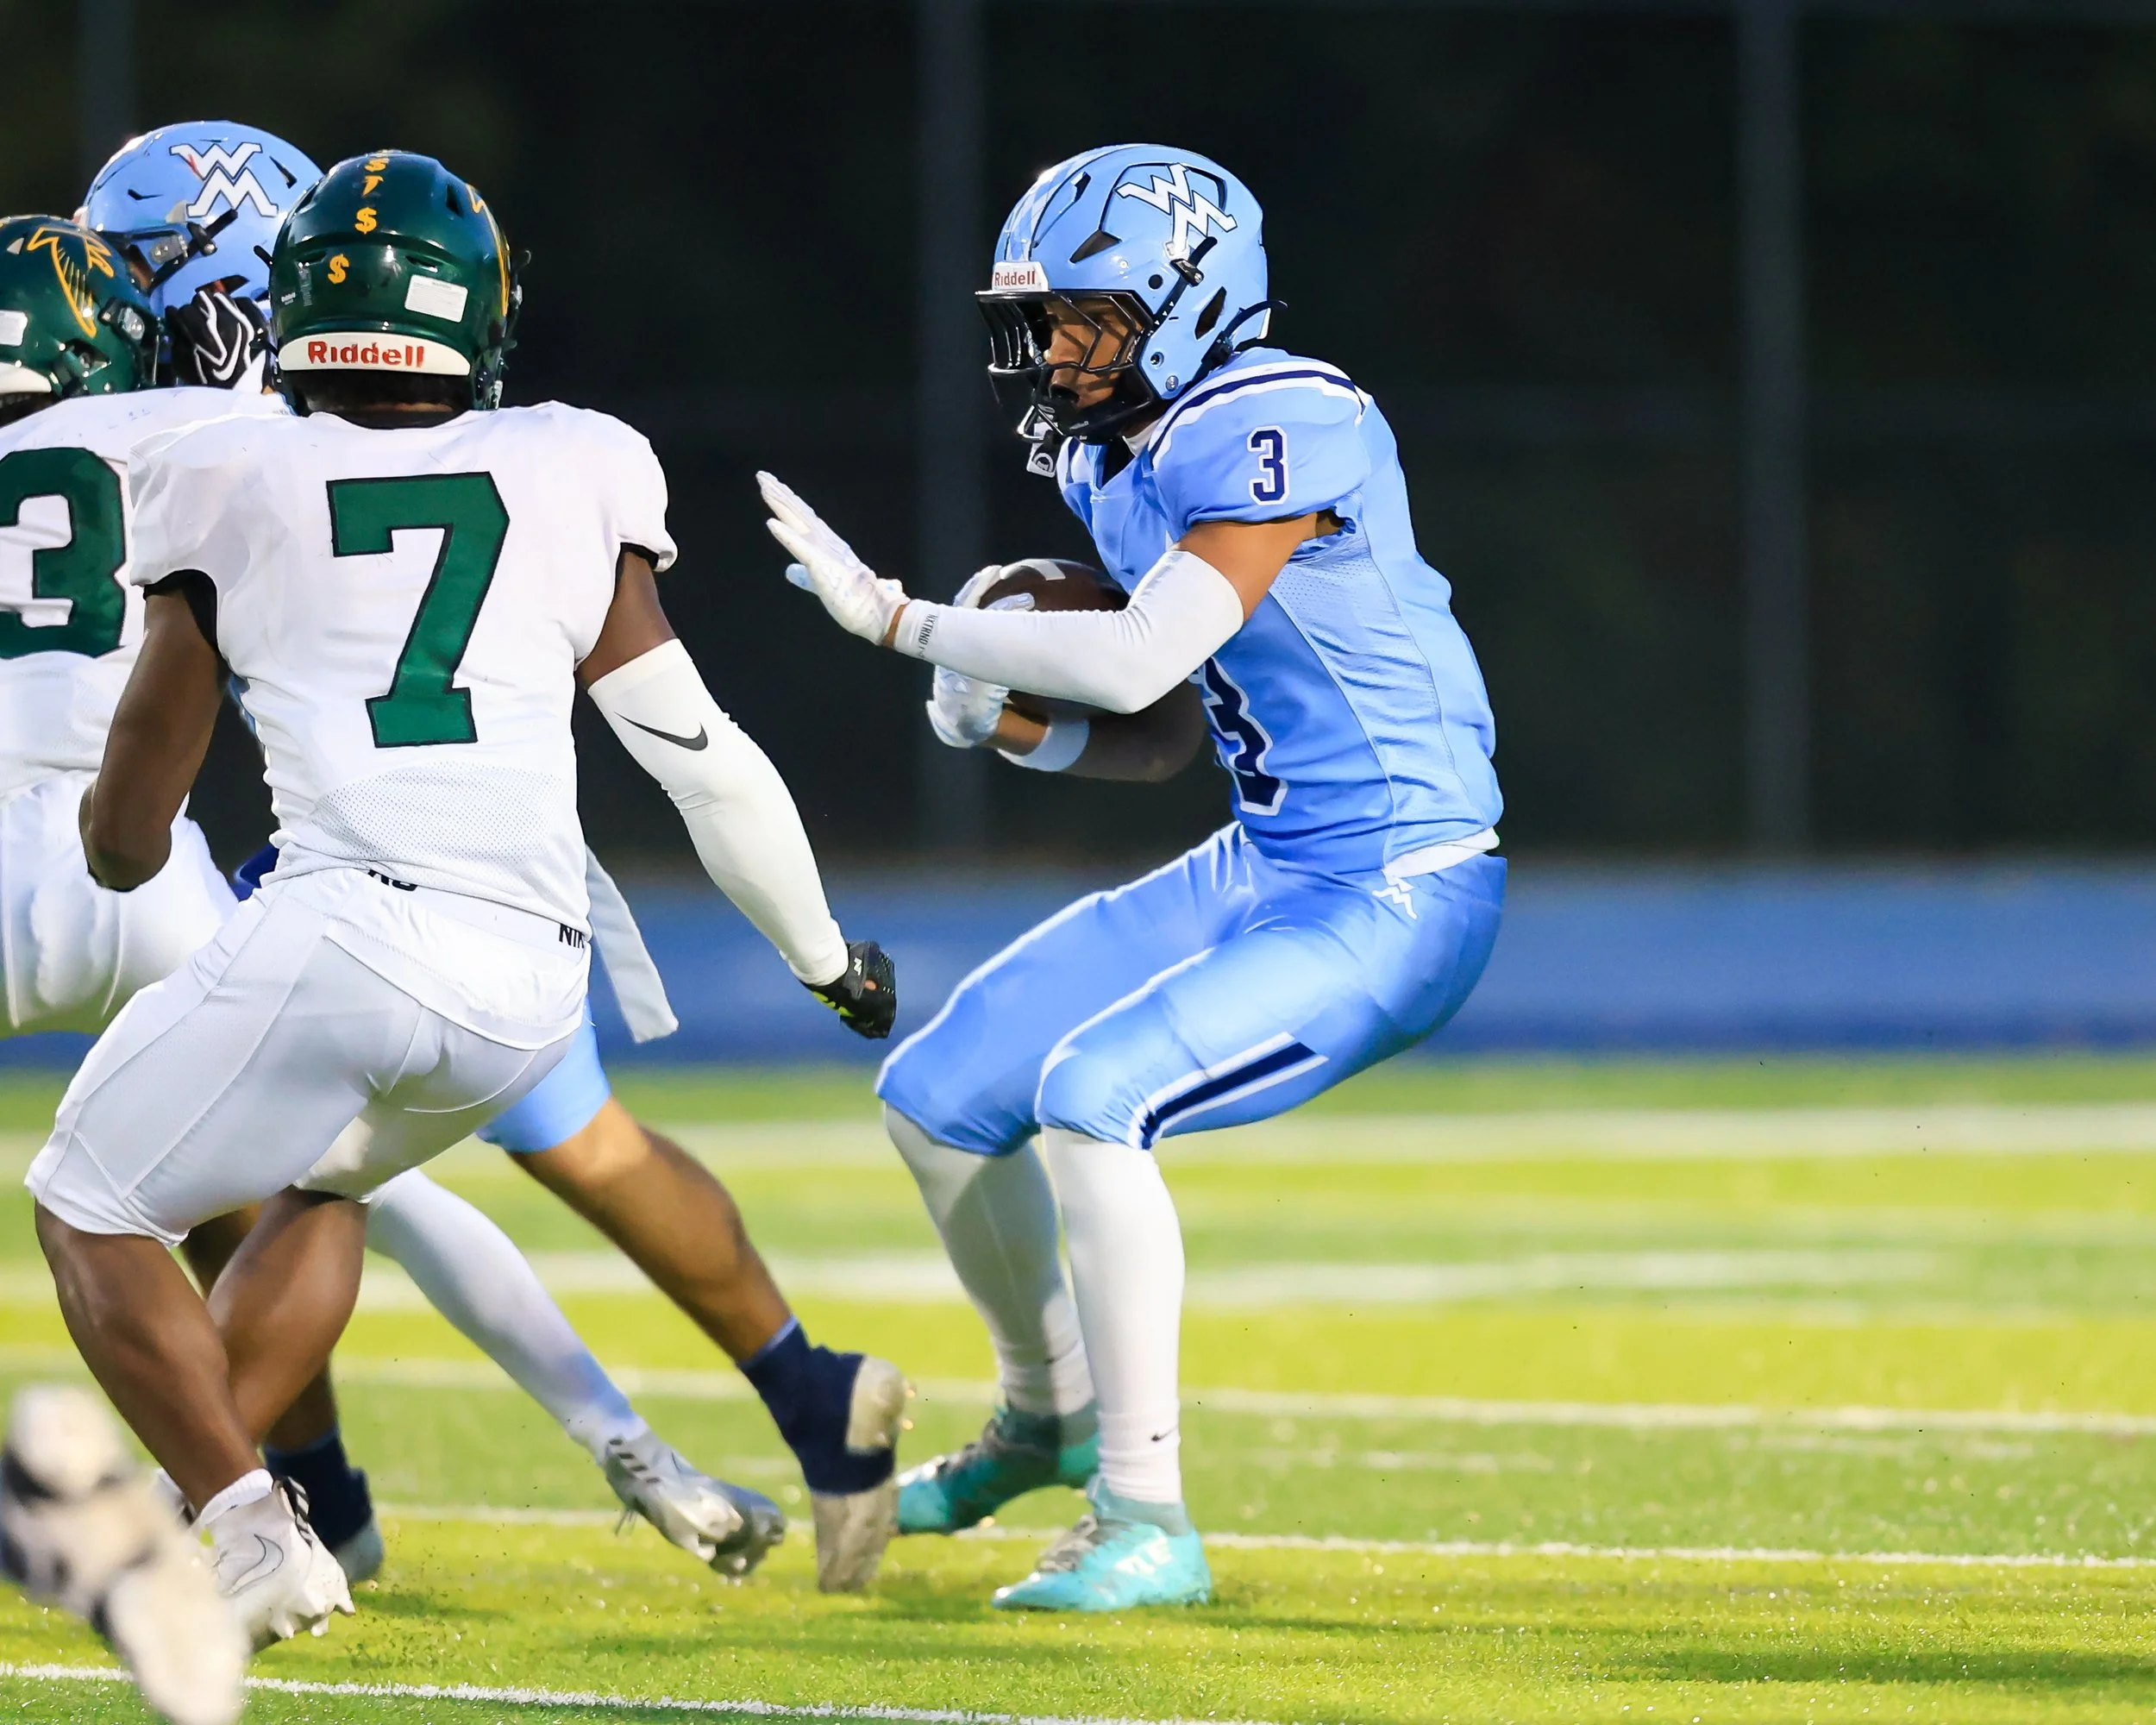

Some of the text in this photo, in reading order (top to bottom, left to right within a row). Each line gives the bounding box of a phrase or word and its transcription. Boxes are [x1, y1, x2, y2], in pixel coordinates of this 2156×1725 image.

[994, 269, 1035, 286] Riddell
[307, 341, 425, 368] Riddell
[1247, 425, 1289, 505] 3
[0, 447, 127, 660] 3
[326, 471, 511, 748] 7
